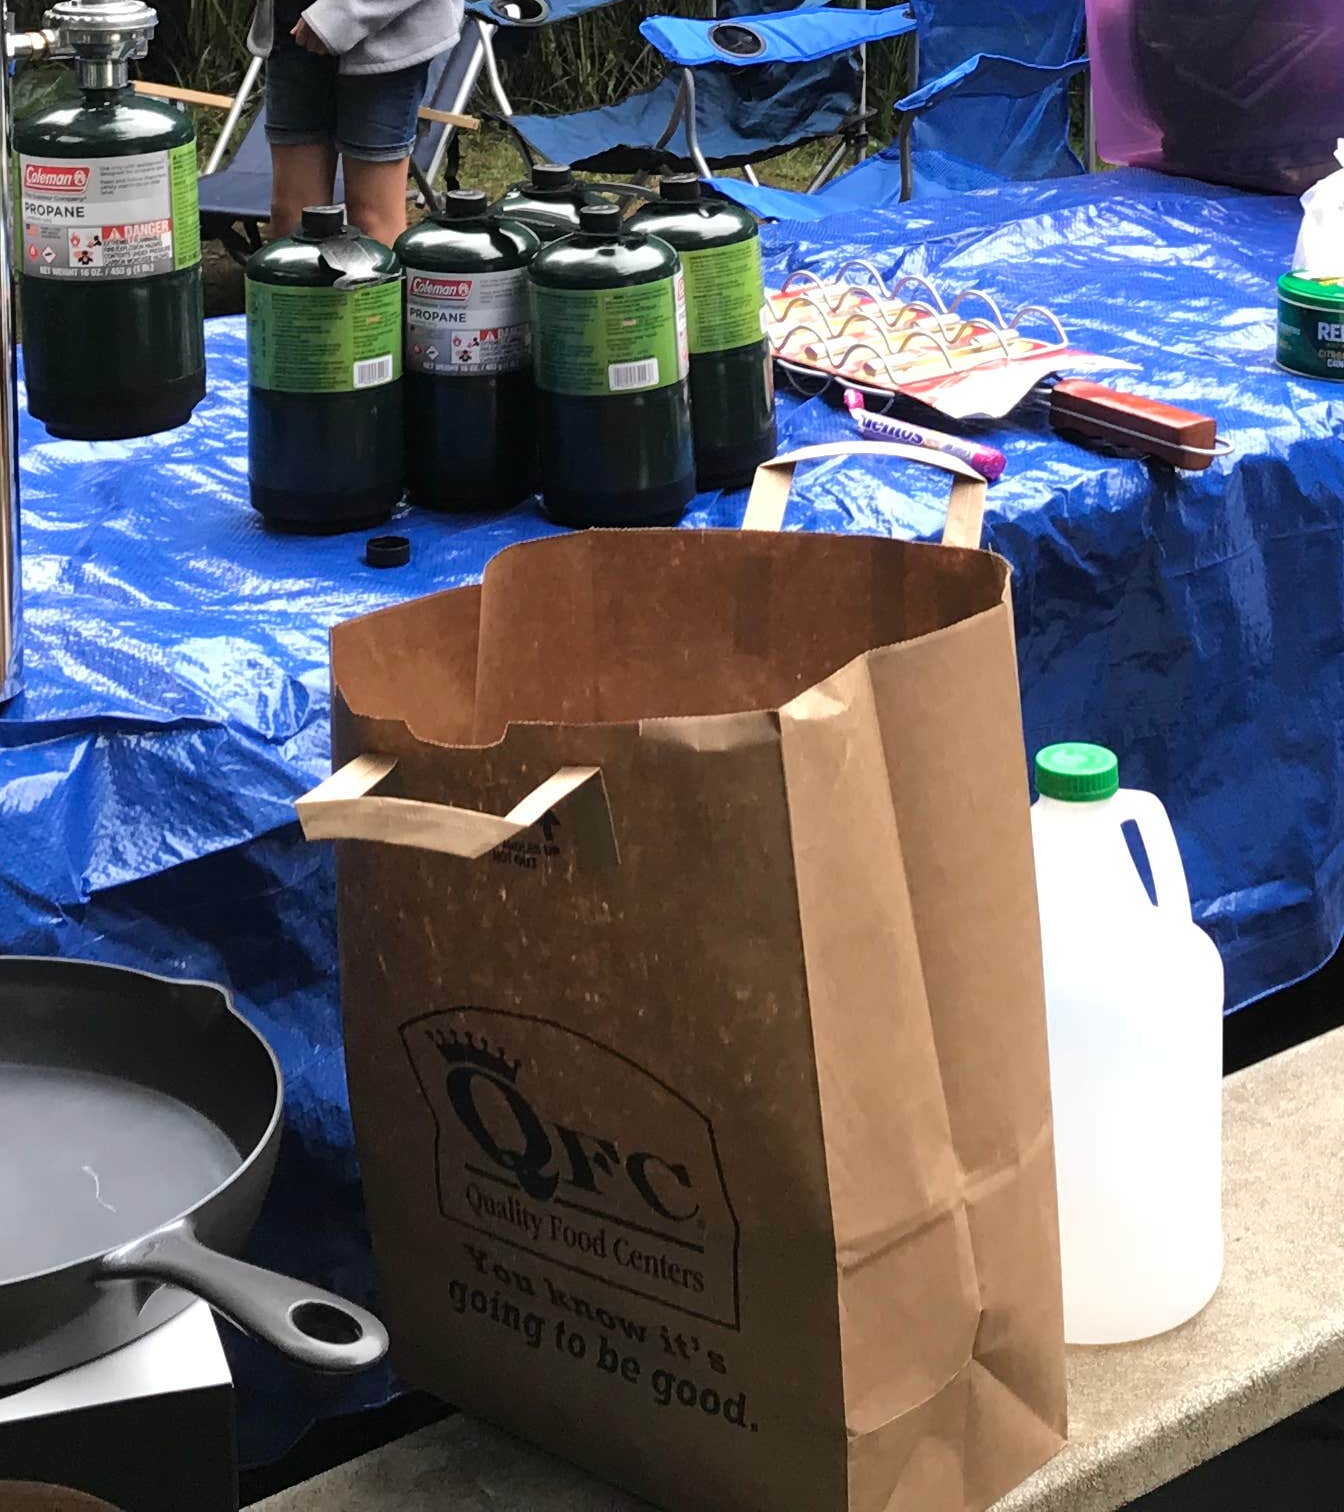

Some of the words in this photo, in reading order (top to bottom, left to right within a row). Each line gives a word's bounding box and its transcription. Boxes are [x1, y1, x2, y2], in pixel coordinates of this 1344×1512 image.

[26, 166, 72, 185] Coleman
[25, 202, 85, 218] PROPANE
[124, 220, 169, 237] DANGER
[80, 268, 90, 276] 16
[413, 278, 457, 295] Coleman
[410, 308, 467, 323] PROPANE
[446, 1066, 701, 1223] QFC
[465, 1182, 543, 1241] Quality
[549, 1212, 606, 1259] Food
[612, 1238, 705, 1294] Centers
[462, 1242, 536, 1296] You
[544, 1276, 647, 1343] know
[659, 1324, 728, 1375] it's
[448, 1279, 546, 1348] going
[555, 1319, 587, 1359] to
[596, 1334, 641, 1384] be
[651, 1367, 759, 1433] good.
